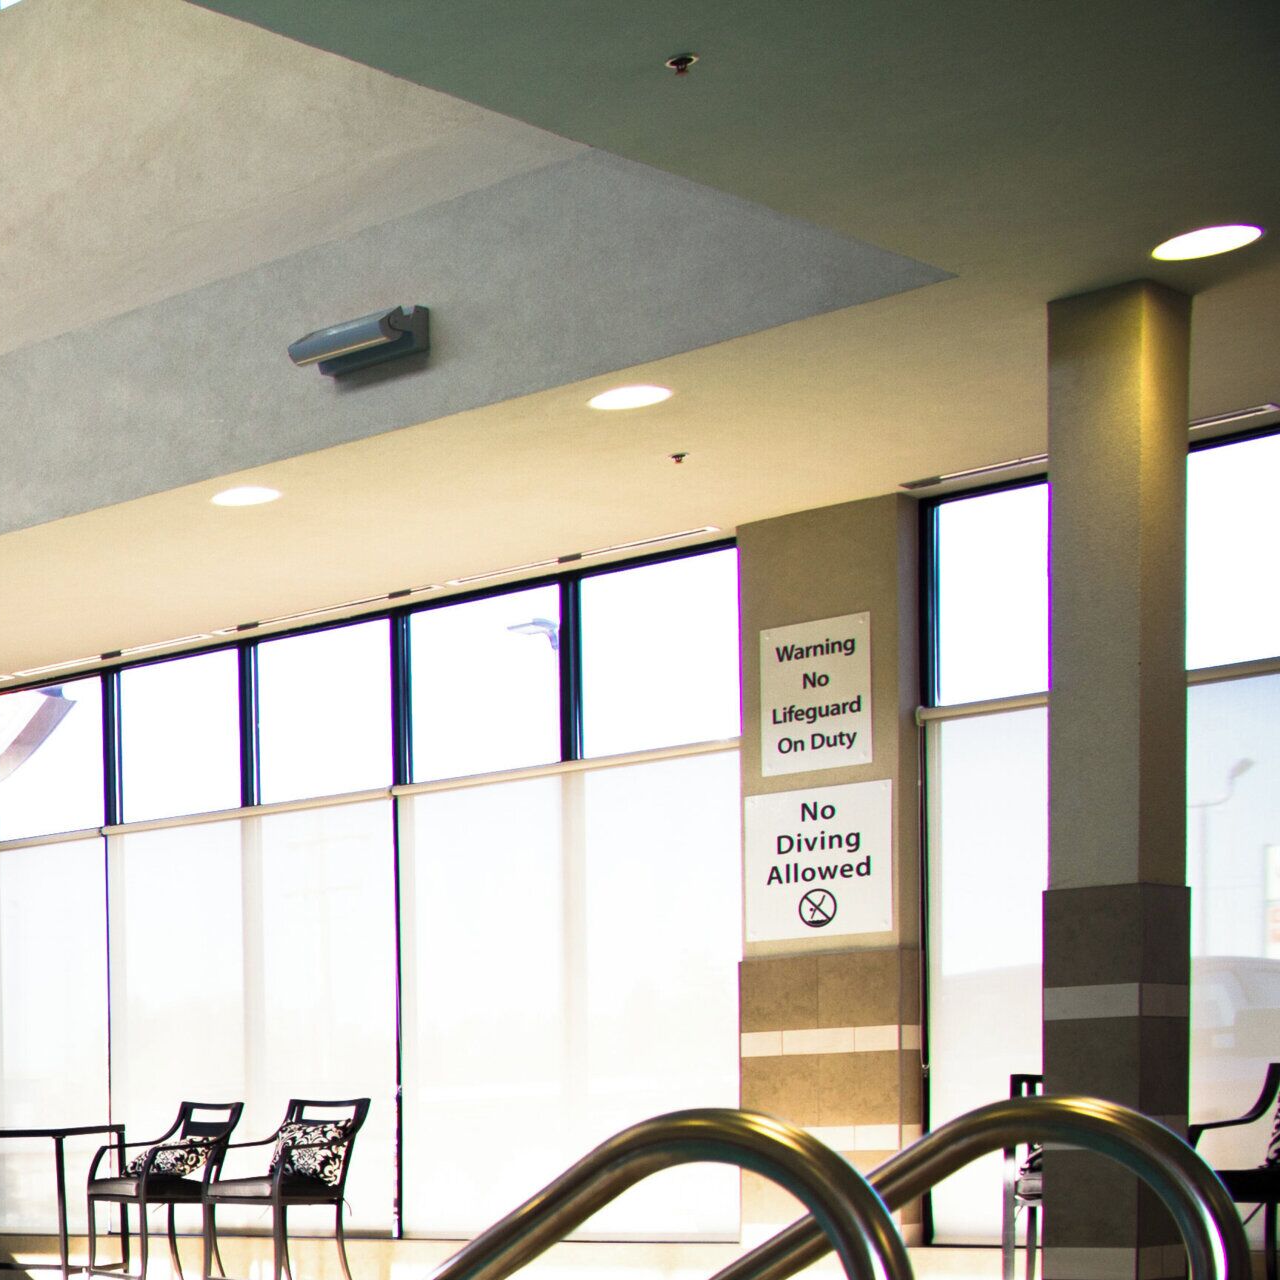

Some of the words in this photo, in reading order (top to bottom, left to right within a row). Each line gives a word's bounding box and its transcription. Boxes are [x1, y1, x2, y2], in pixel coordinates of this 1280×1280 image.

[775, 637, 856, 663] Warning
[802, 671, 830, 690] No
[772, 694, 862, 725] Lifeguard
[777, 736, 805, 755] On
[811, 729, 857, 751] Duty
[800, 801, 836, 822] No
[776, 830, 861, 855] Diving
[767, 855, 871, 886] Allowed
